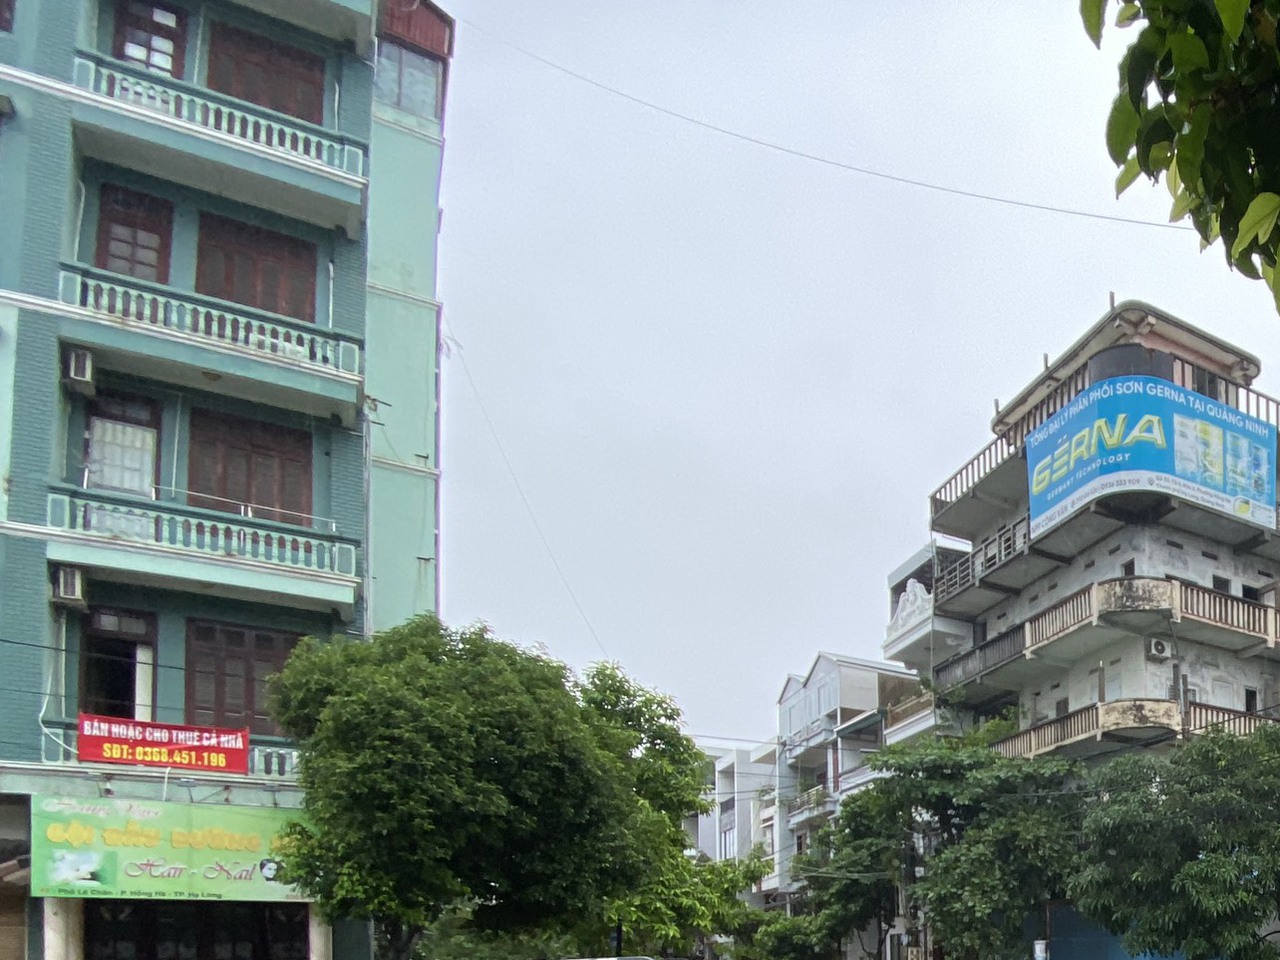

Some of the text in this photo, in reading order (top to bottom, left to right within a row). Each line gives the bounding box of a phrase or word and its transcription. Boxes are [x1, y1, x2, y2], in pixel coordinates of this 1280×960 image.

[1069, 395, 1089, 418] PHÂN
[1115, 380, 1144, 395] SƠN
[1146, 382, 1187, 406] GERNA
[1187, 395, 1205, 414] TẠI
[1245, 419, 1269, 439] NINH
[1075, 452, 1132, 481] TECHNOLOGY
[83, 719, 109, 737] BÁN
[111, 722, 143, 743] HOẶC
[145, 726, 169, 743] CHO
[172, 729, 201, 746] THUÊ
[135, 745, 227, 768] 0368.451.196
[125, 857, 187, 879] Hair
[203, 860, 257, 881] Nail
[201, 891, 222, 900] Long
